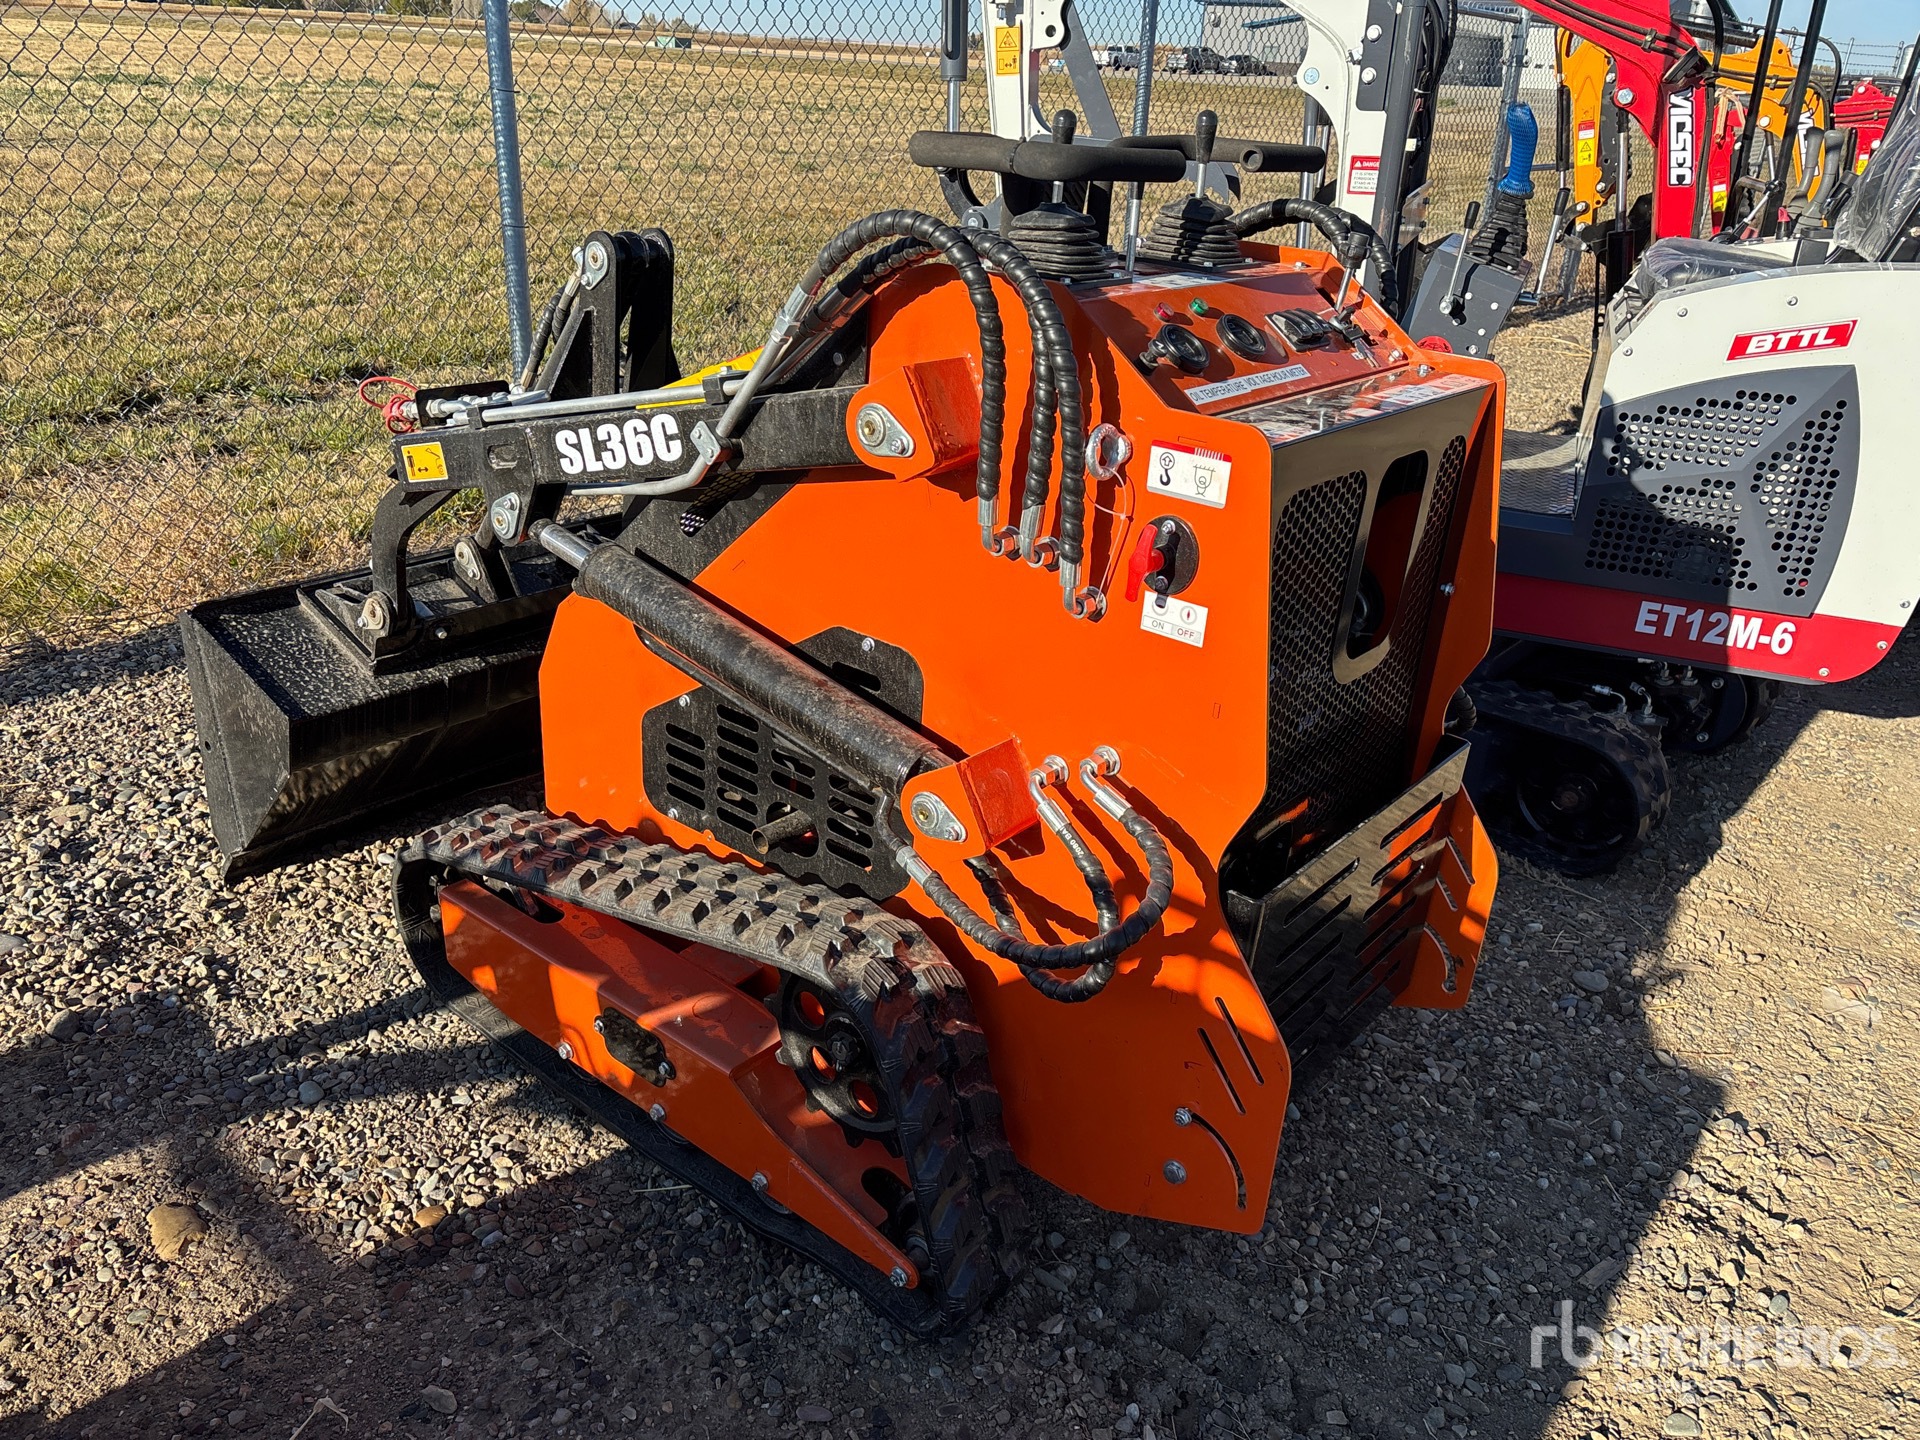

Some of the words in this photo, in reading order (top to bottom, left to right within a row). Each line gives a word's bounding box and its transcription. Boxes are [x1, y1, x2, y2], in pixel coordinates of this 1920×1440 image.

[1745, 327, 1837, 355] BTTL
[1201, 380, 1247, 398] TEMPERATURE
[555, 414, 683, 475] SL36C
[1151, 620, 1165, 630] ON
[1177, 628, 1195, 639] OFF
[1635, 601, 1797, 656] ET12M-6
